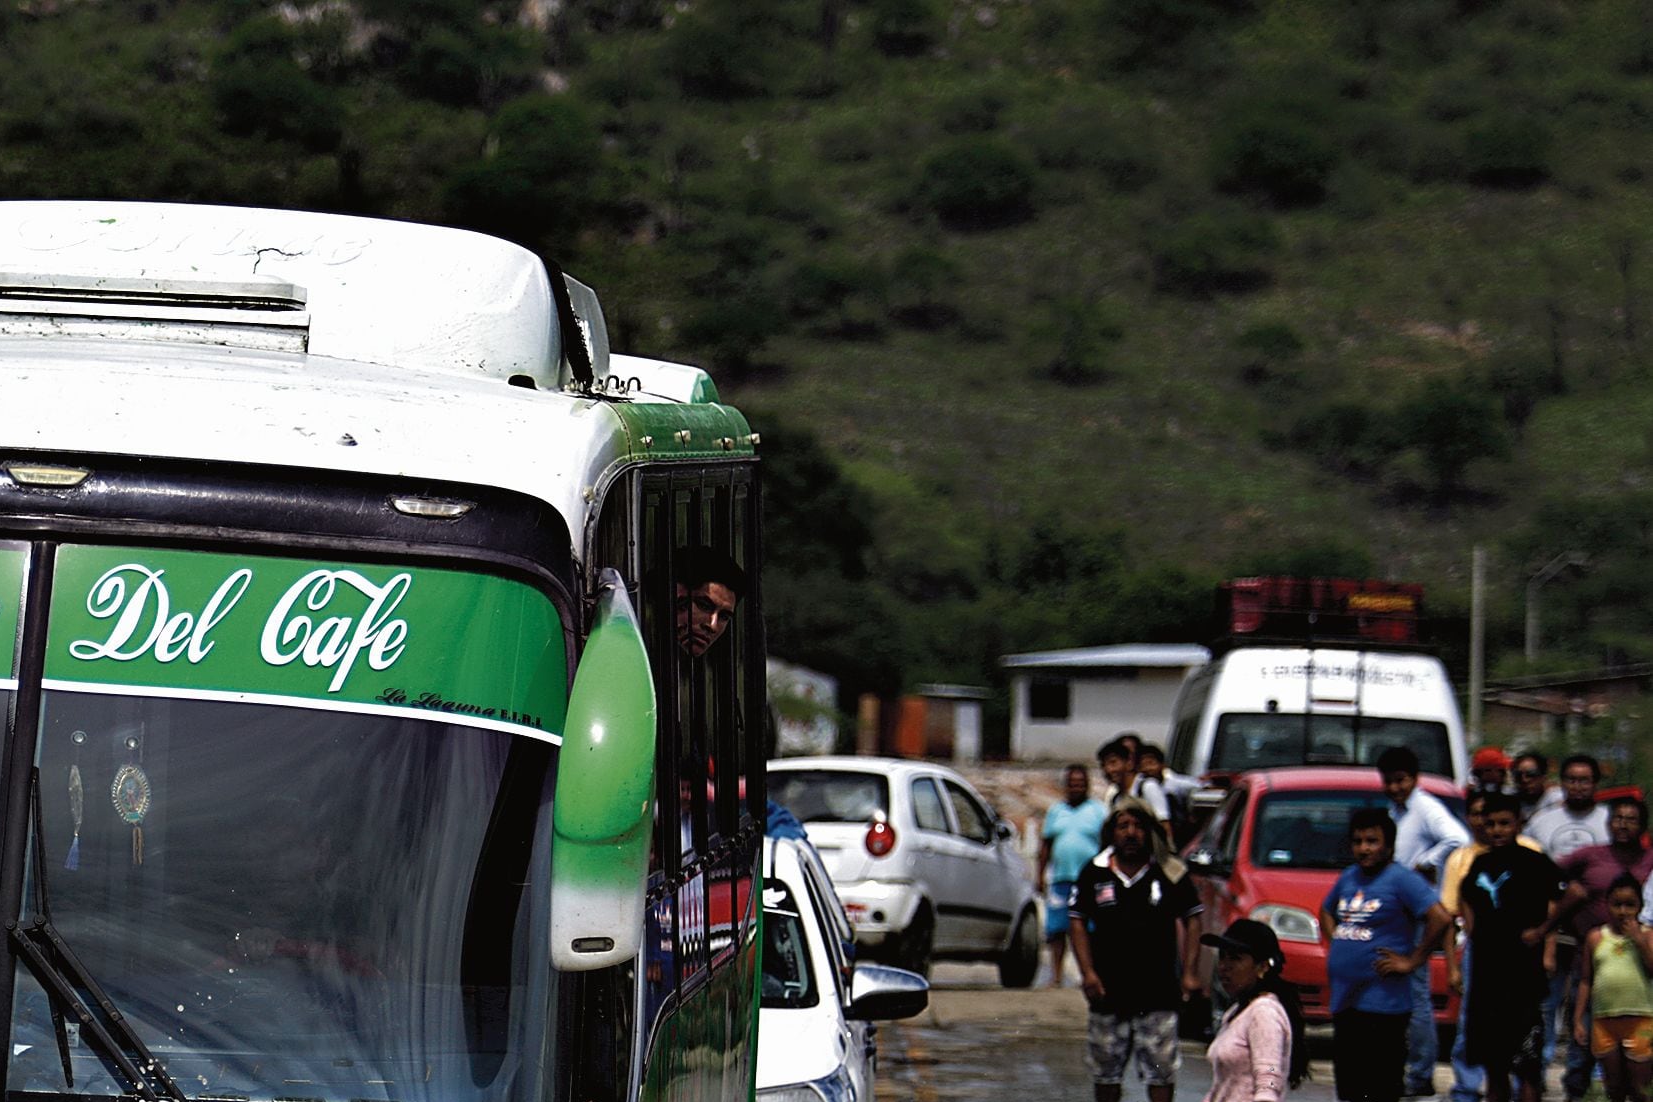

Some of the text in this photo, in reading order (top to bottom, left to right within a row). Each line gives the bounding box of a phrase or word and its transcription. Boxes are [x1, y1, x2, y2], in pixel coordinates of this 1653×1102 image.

[68, 562, 253, 665] Del
[260, 568, 413, 694] Cafe
[375, 687, 408, 705] La
